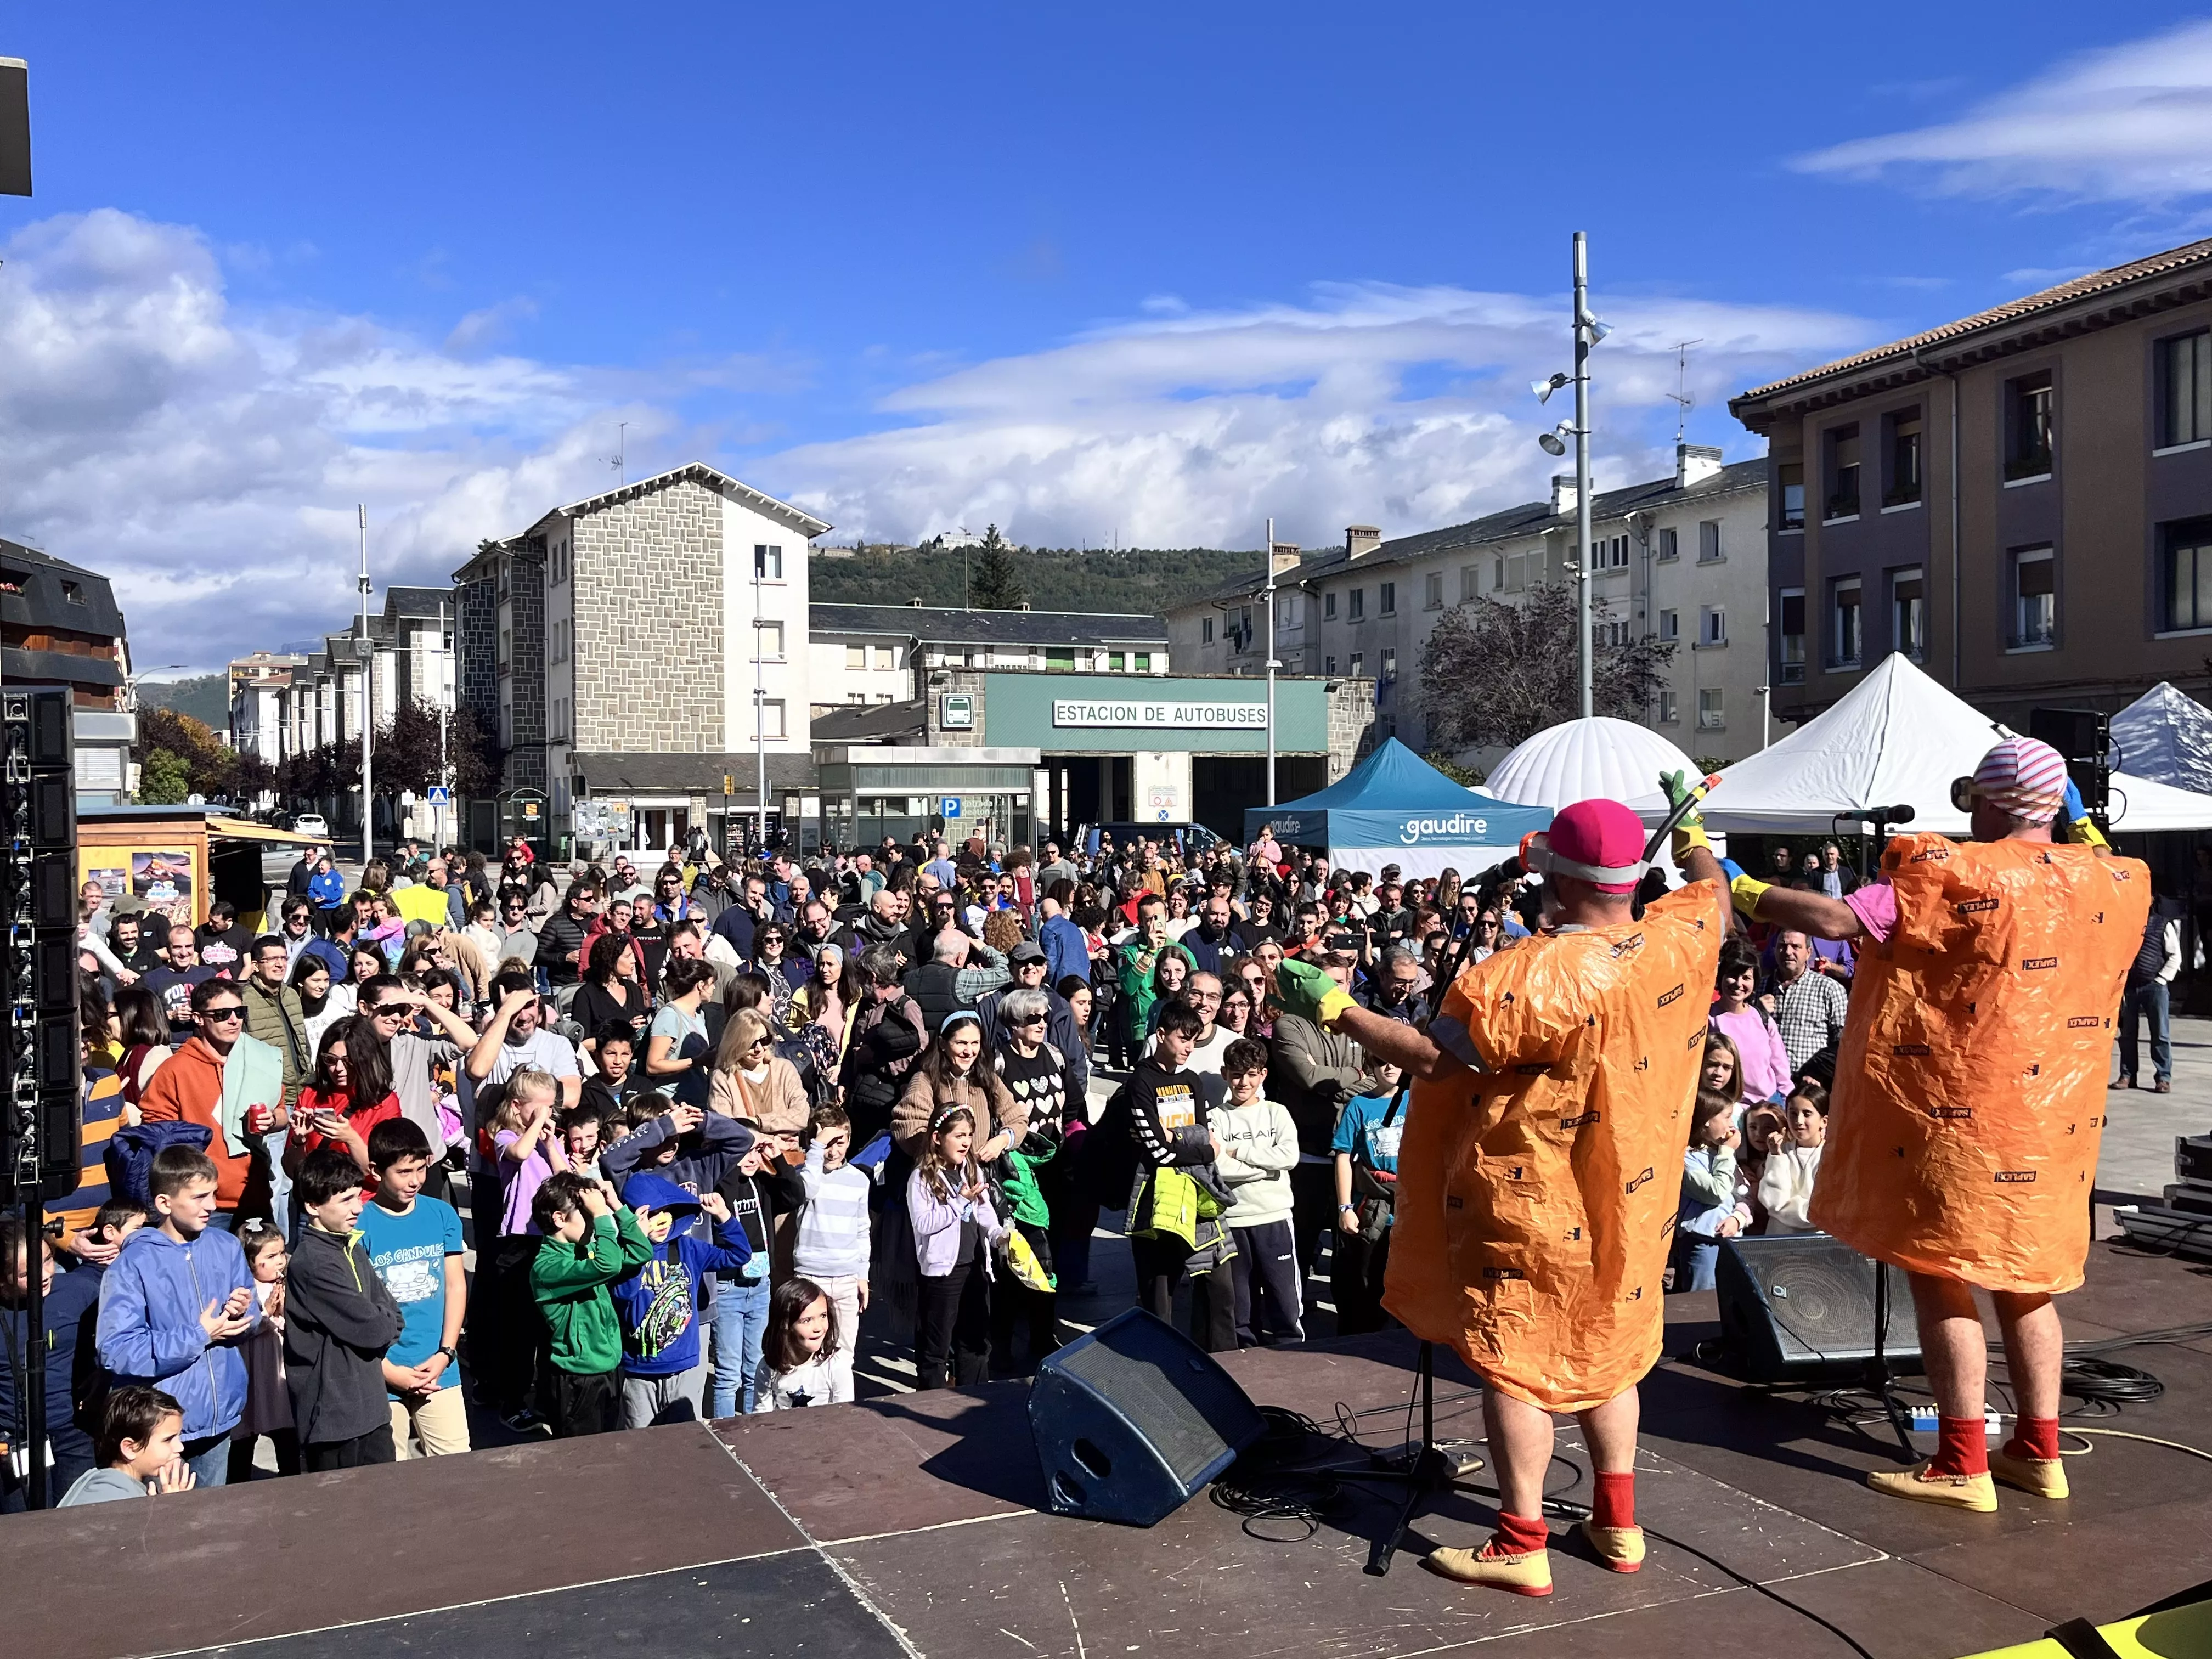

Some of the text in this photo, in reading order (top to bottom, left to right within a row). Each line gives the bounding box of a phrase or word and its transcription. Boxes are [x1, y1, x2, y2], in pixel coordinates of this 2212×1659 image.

[1057, 706, 1266, 723] ESTACION DE AUTOBUSES
[945, 800, 957, 816] P
[2027, 959, 2056, 969] SAPLEX
[1999, 1172, 2035, 1182] SAPLEX
[368, 1243, 444, 1269] LOS GANDULES
